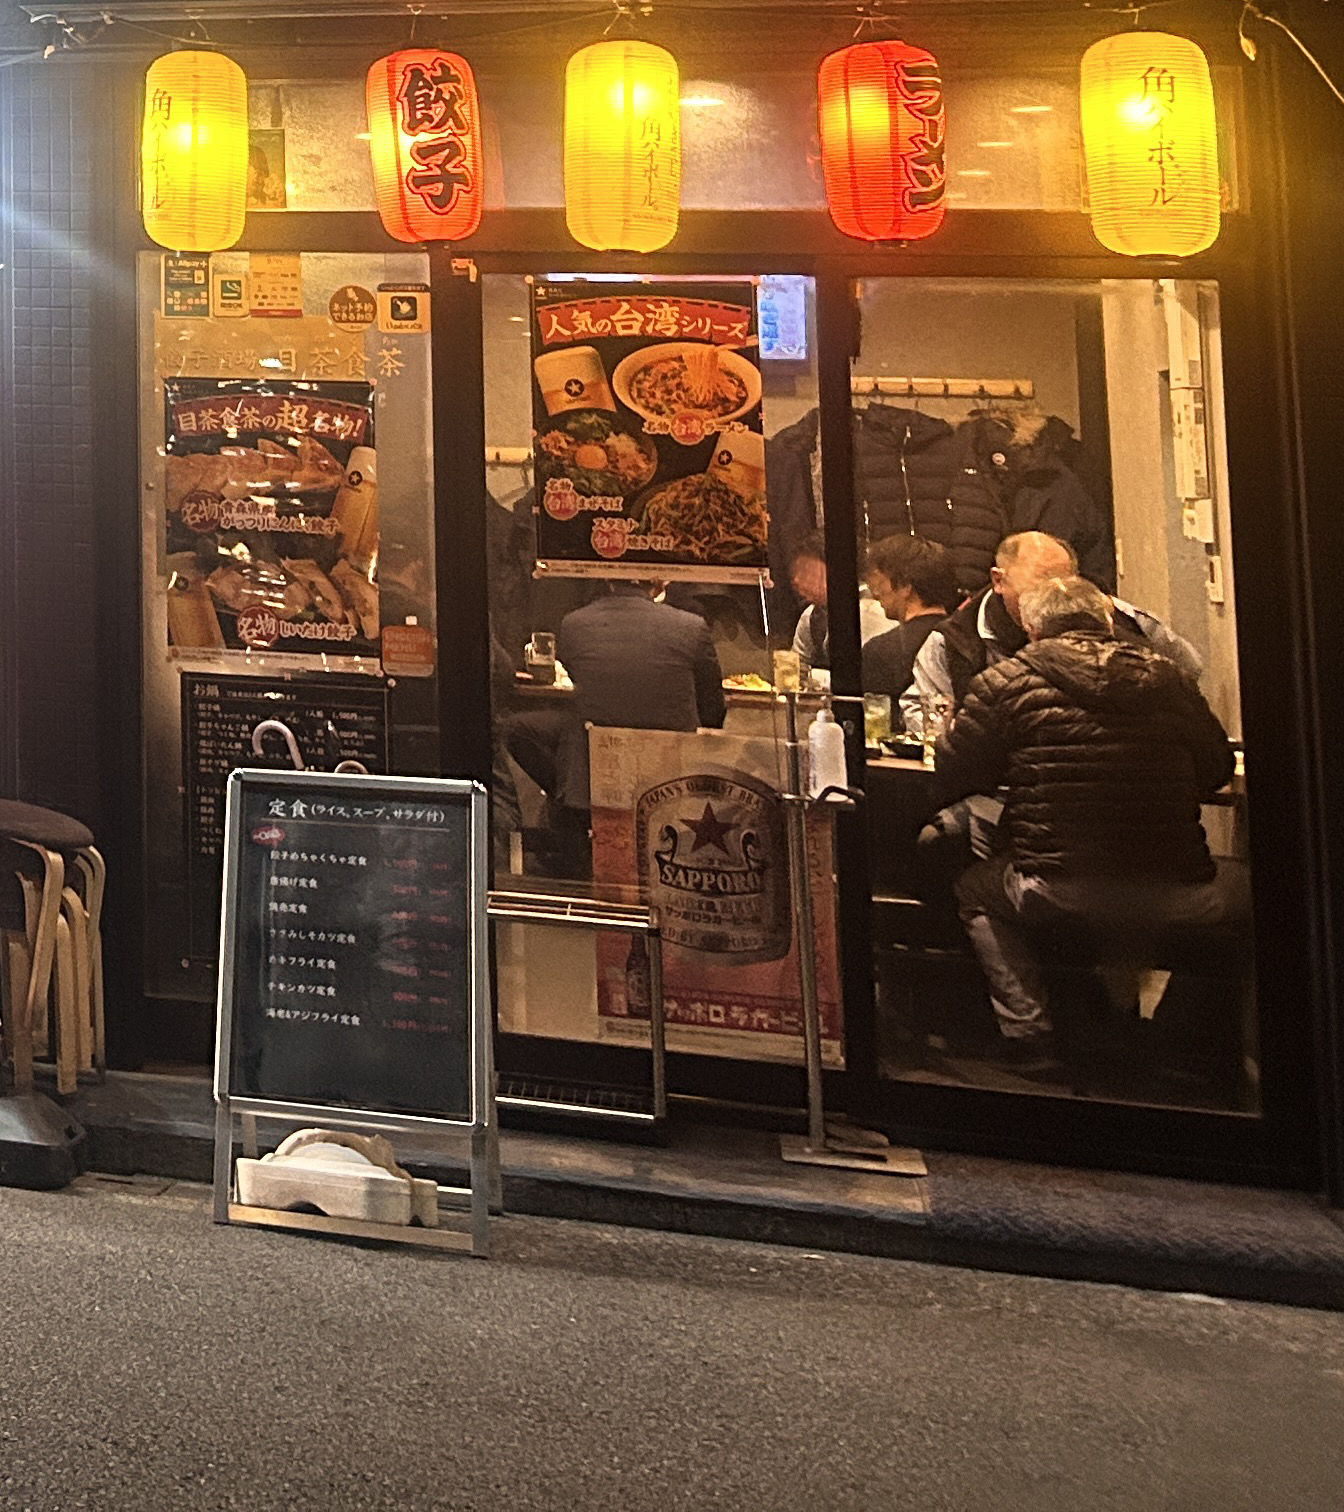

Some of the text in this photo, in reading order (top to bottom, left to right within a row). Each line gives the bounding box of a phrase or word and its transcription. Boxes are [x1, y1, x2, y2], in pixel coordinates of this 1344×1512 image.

[149, 87, 173, 211] 角ハイボール
[404, 60, 473, 212] 餃子
[1137, 65, 1179, 207] 角ハイボール
[545, 301, 749, 340] 人気の台湾シリーズ
[177, 399, 363, 438] 目茶食茶の超名物!
[181, 498, 219, 526] 名物
[237, 613, 277, 638] 名物
[661, 864, 764, 892] SAPPORO
